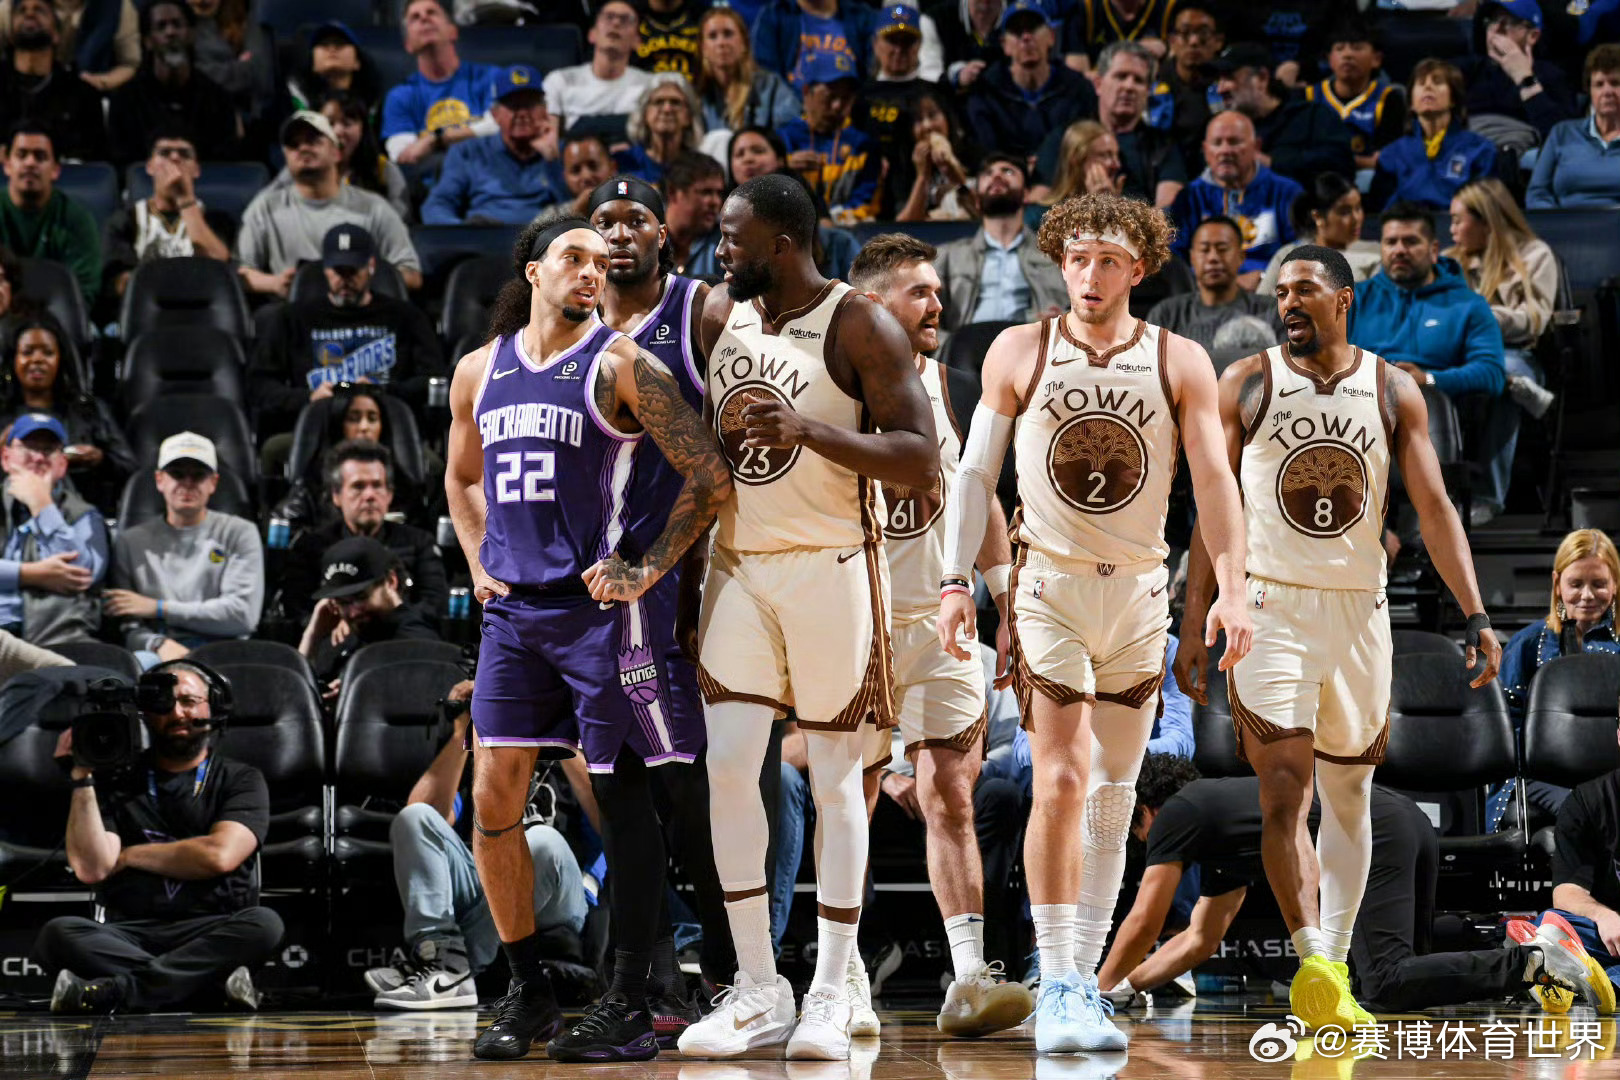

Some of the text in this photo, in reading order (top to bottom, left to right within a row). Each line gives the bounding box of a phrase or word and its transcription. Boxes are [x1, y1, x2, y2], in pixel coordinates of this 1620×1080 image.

[789, 327, 821, 339] Rakuten
[719, 346, 737, 362] The
[714, 353, 810, 400] TOWN
[1115, 363, 1152, 374] Rakuten
[1044, 380, 1065, 397] The
[1342, 386, 1374, 398] Rakuten
[1040, 384, 1156, 429] TOWN
[1272, 410, 1293, 427] The
[479, 403, 584, 450] SACRAMENTO
[1268, 412, 1376, 455] TOWN
[738, 445, 771, 475] 23
[496, 451, 556, 502] 22
[1086, 471, 1107, 503] 2
[891, 499, 915, 530] 61
[1314, 497, 1333, 528] 8
[620, 664, 657, 686] KINGS
[347, 946, 408, 967] CHA
[1209, 938, 1300, 959] HASE
